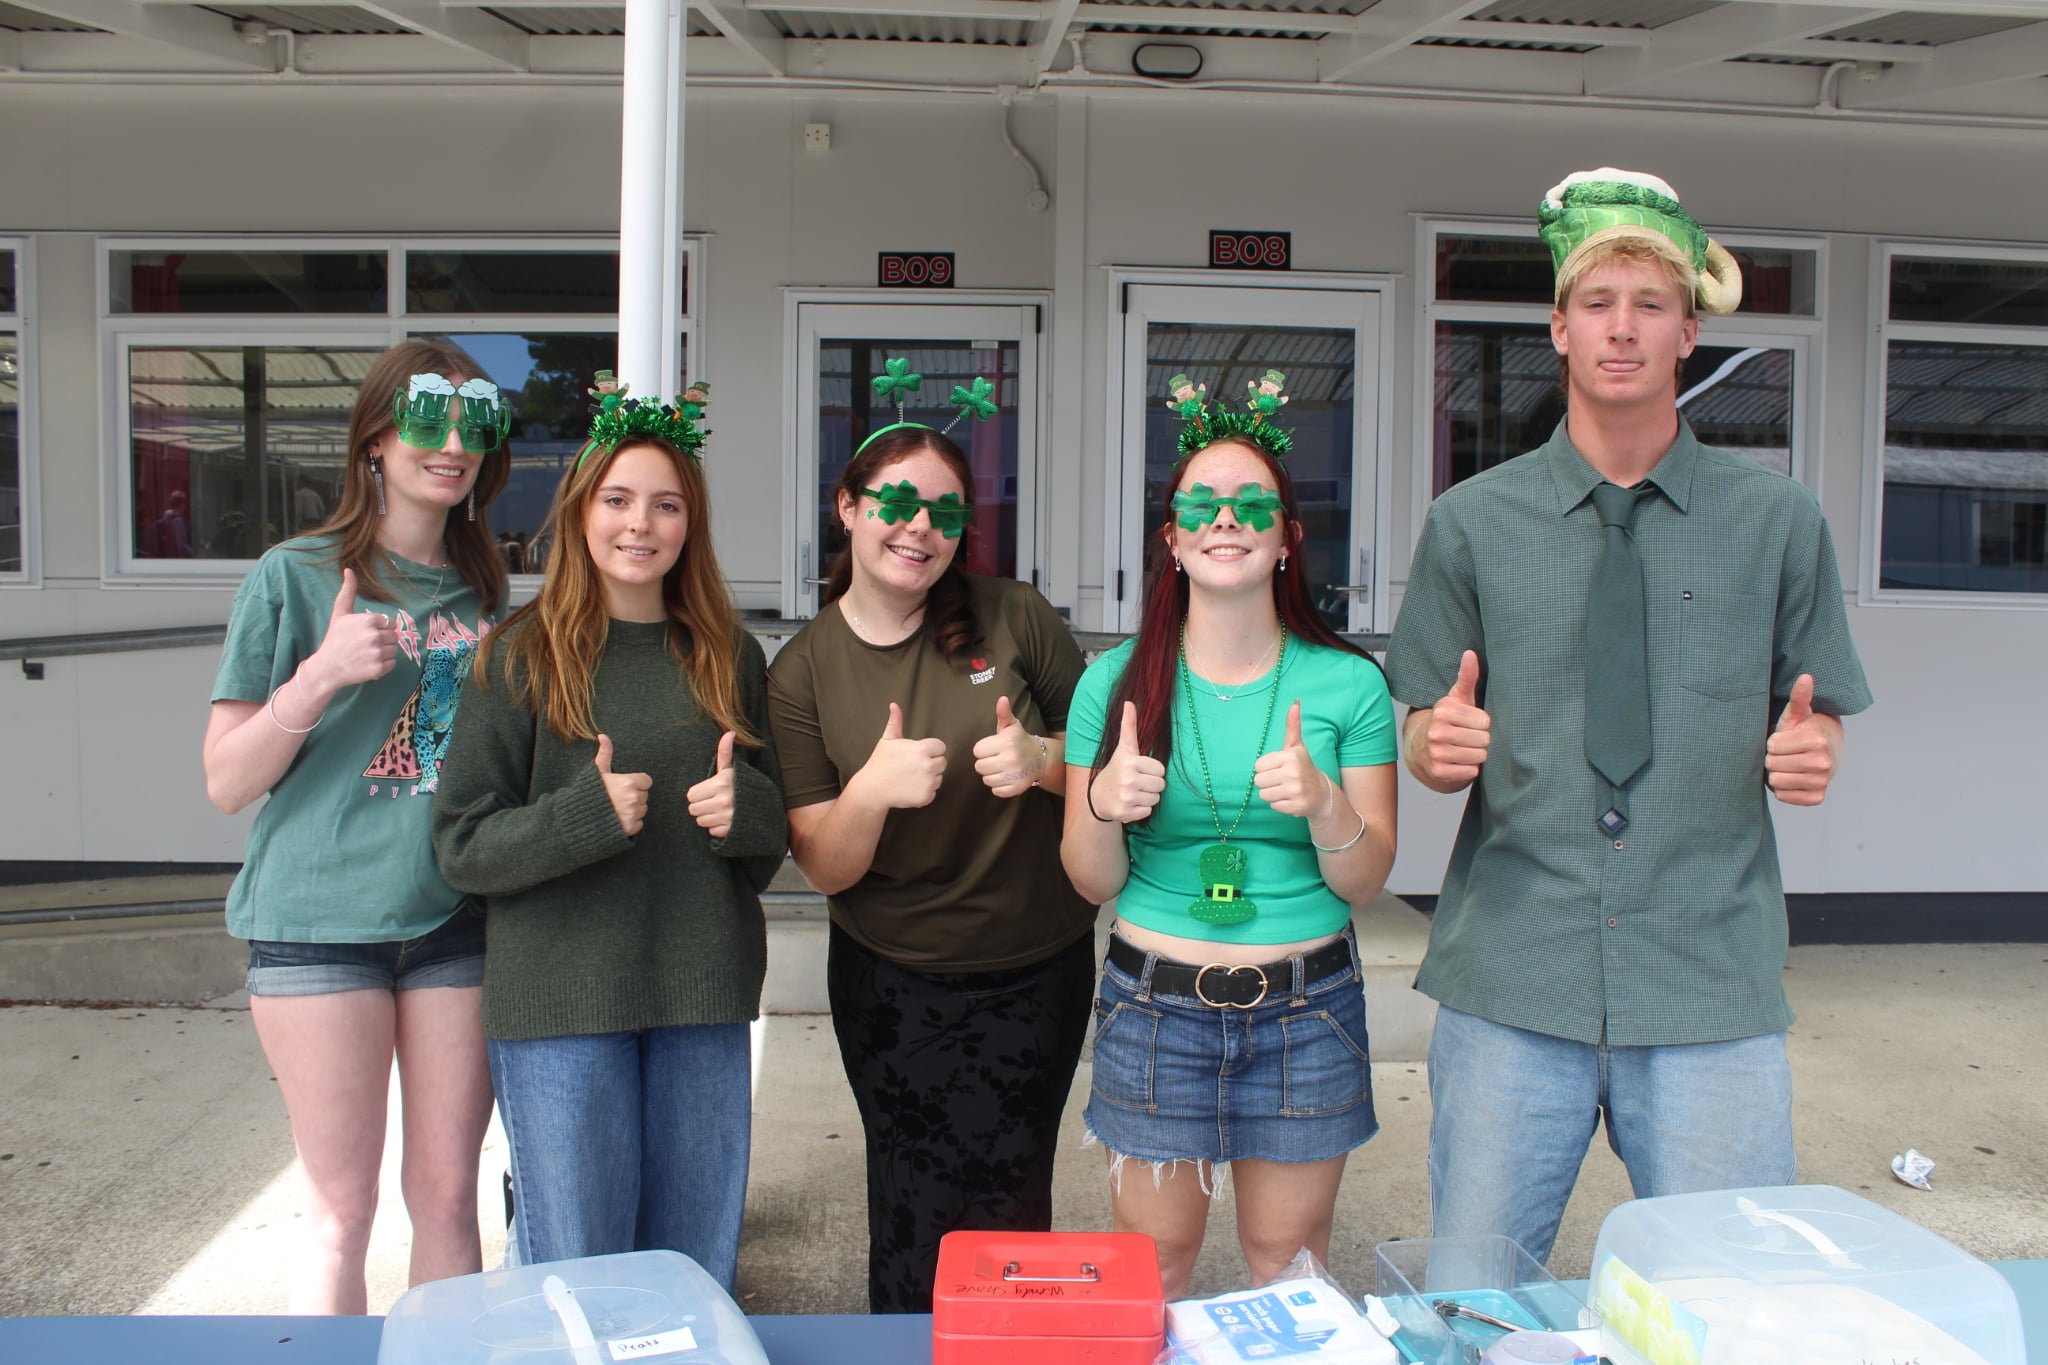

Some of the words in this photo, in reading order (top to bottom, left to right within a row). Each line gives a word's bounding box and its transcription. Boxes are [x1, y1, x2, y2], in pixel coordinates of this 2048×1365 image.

[1214, 235, 1287, 266] B08
[882, 256, 951, 284] B09
[970, 666, 996, 680] STONEY
[972, 674, 994, 685] CREEK
